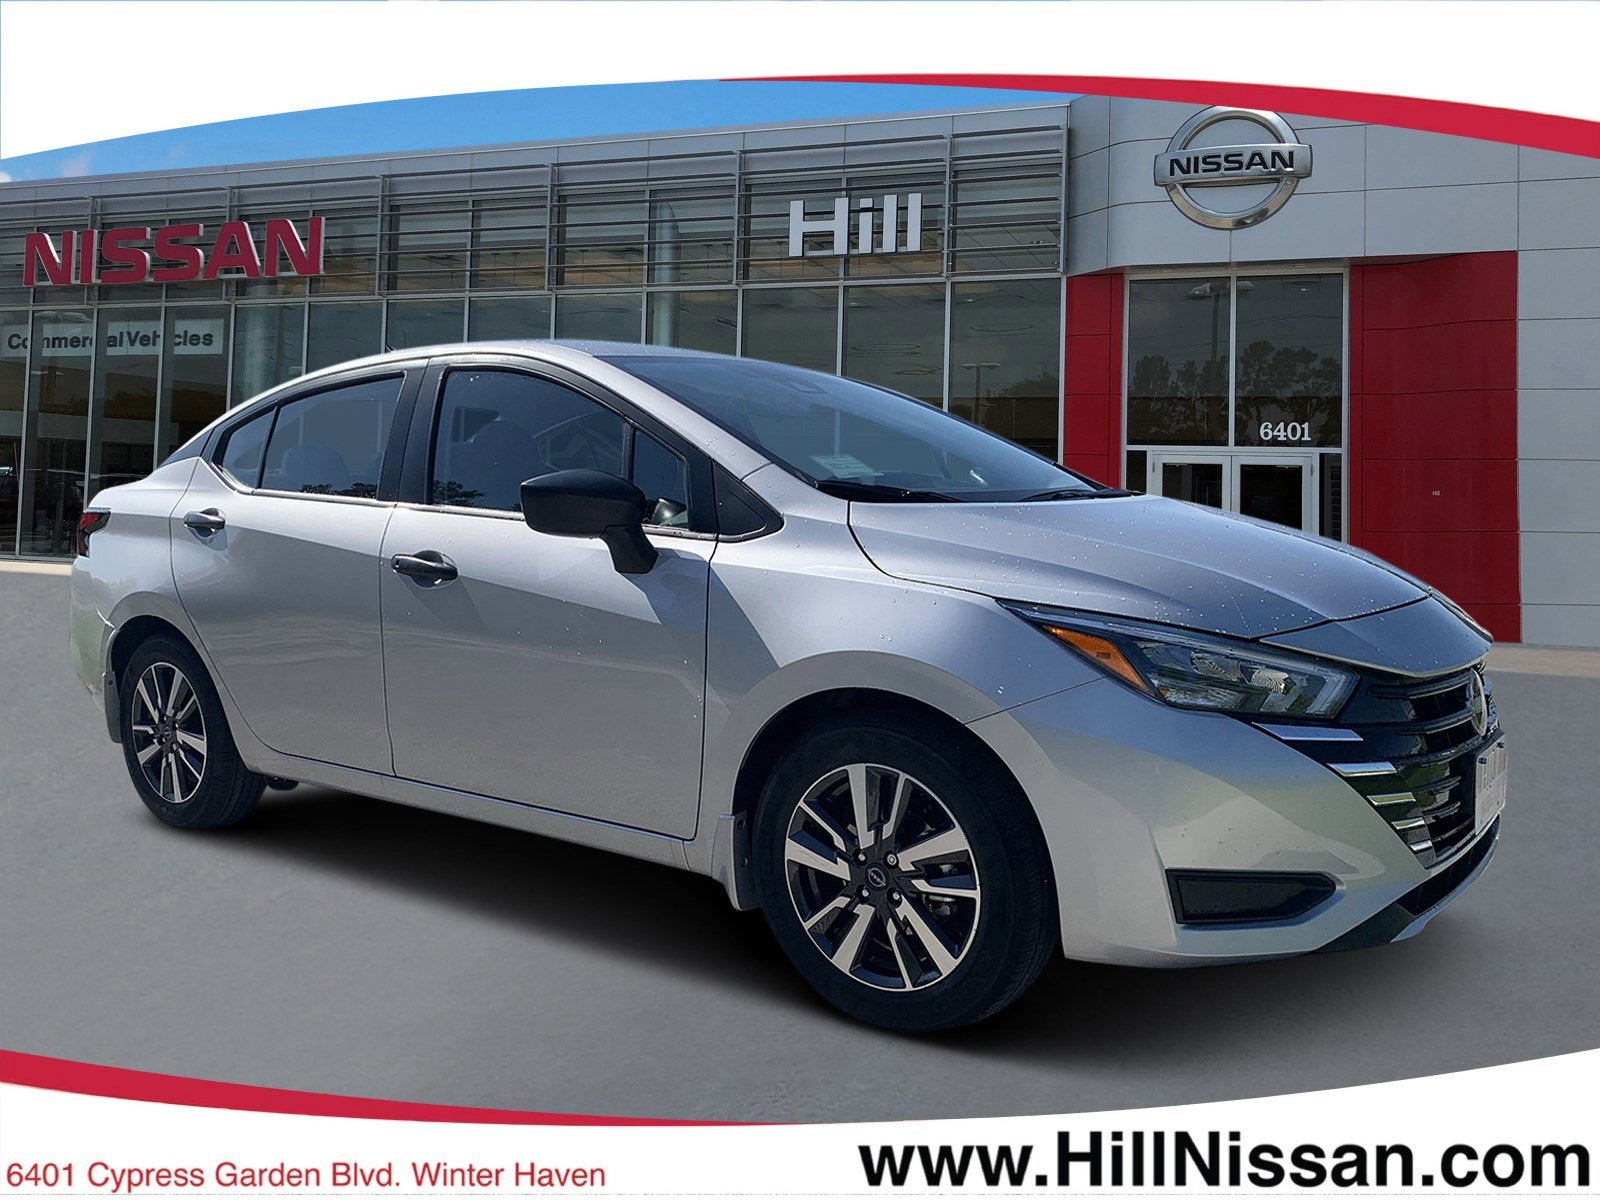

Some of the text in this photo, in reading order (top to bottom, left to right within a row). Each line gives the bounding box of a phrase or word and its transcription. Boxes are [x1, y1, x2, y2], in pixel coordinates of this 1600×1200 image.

[1169, 150, 1295, 177] NISSAN
[788, 192, 922, 257] Hill
[23, 216, 325, 287] NISSAN
[1259, 421, 1312, 441] 6401
